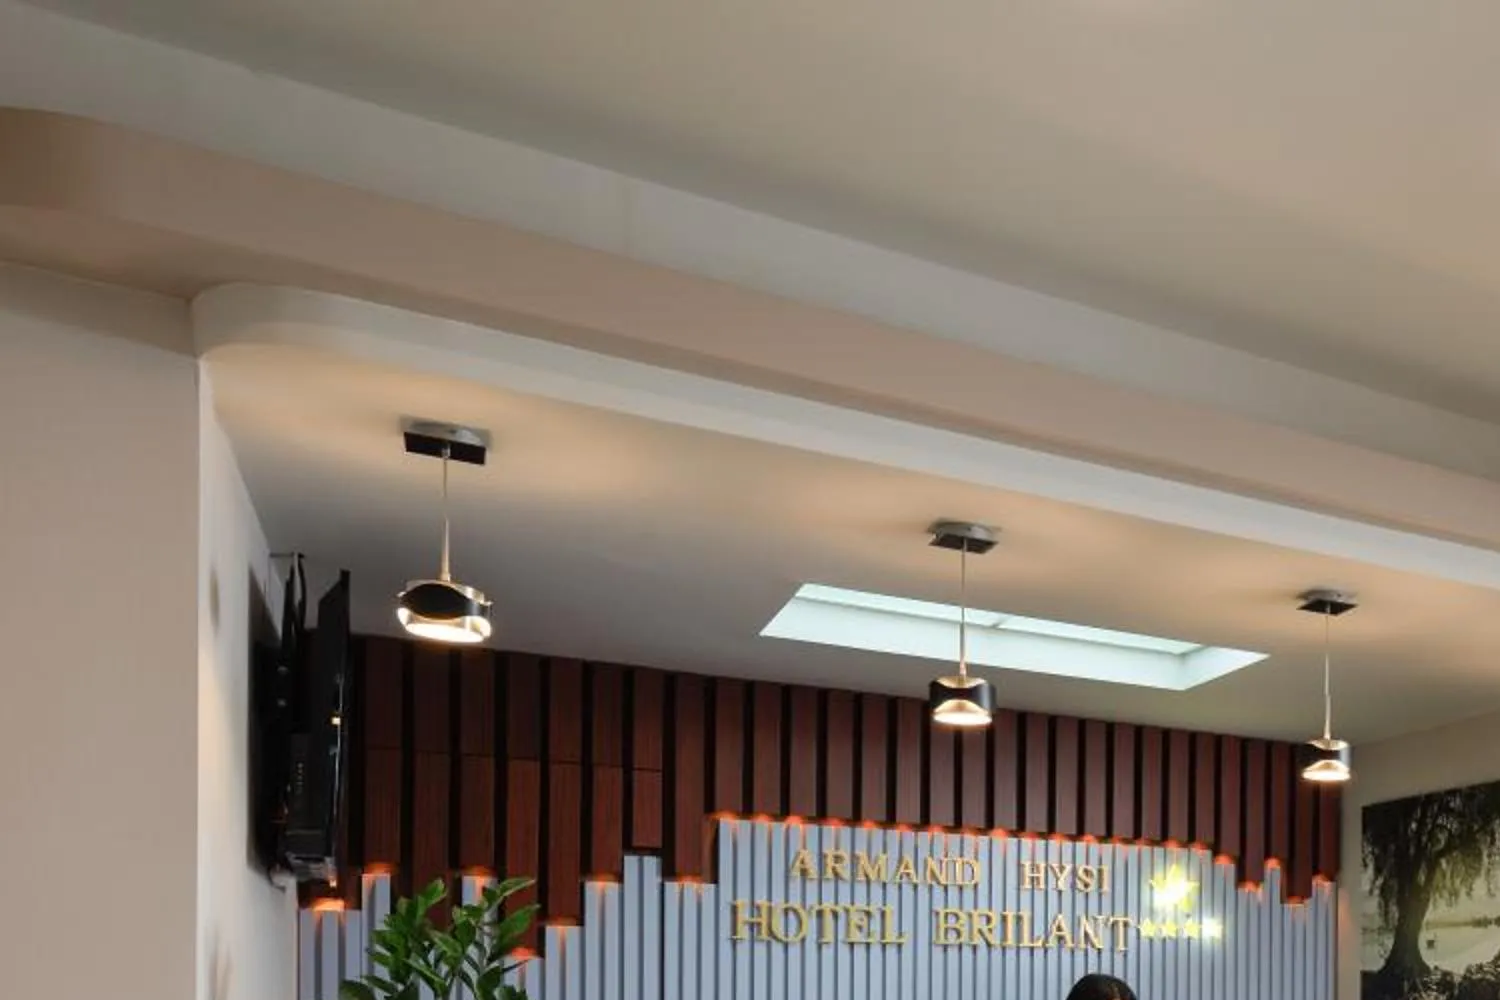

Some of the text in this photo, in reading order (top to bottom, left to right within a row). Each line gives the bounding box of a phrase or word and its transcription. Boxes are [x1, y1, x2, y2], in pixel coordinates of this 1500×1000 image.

[789, 848, 1111, 894] ARMAND HYSI
[730, 899, 1133, 952] HOTEL BRILANT
